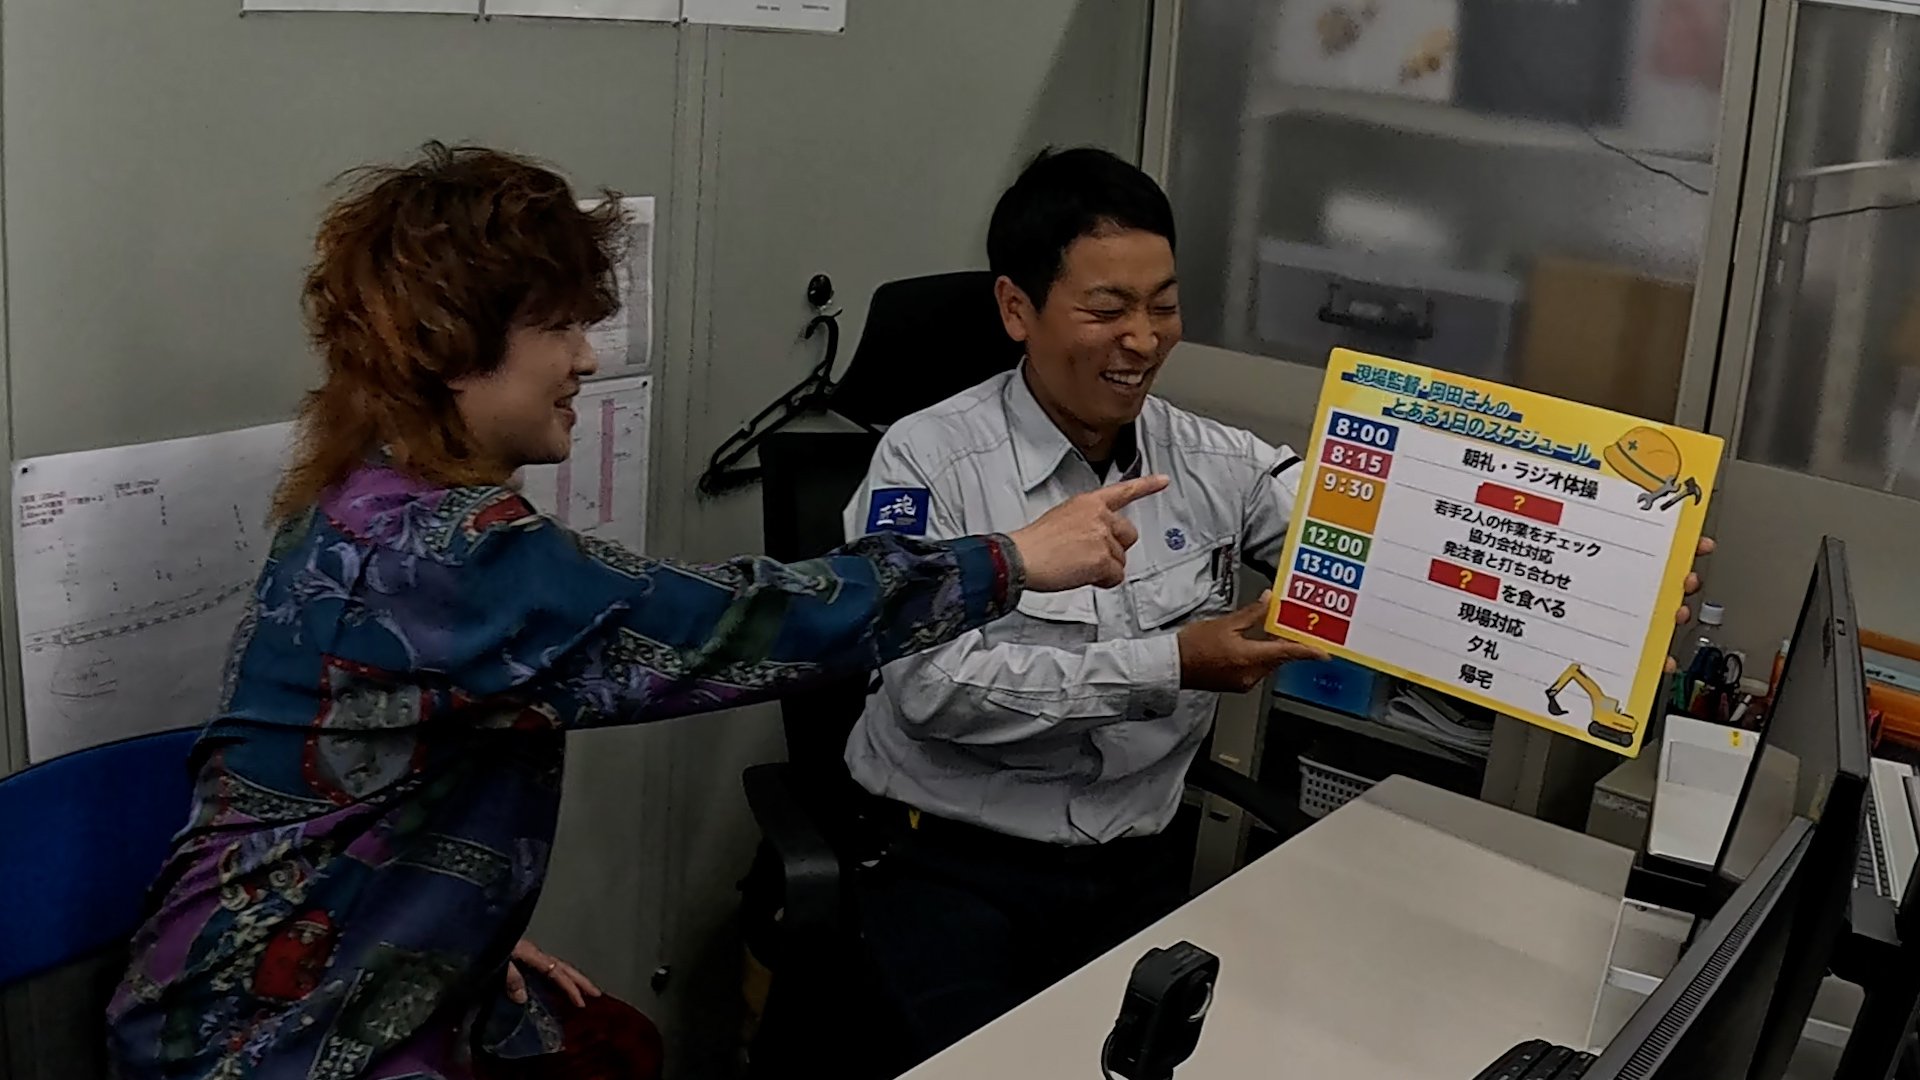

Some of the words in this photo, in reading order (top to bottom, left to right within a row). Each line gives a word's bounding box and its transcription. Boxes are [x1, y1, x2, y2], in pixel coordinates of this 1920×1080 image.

[1336, 418, 1389, 445] 8:00
[1391, 397, 1592, 463] とある1日のスケジュール
[1331, 445, 1382, 473] 8:15
[1462, 448, 1598, 500] 朝礼・ラジオ体操
[1324, 473, 1374, 501] 9:30
[1308, 526, 1363, 556] 12:00
[1434, 499, 1601, 557] 若手2人の作業をチェック
[1469, 527, 1555, 564] 協力会社対応
[1301, 553, 1356, 584] 13:00
[1443, 541, 1572, 590] 発注者と打ち合わせ
[1294, 580, 1350, 612] 17:00
[1502, 584, 1566, 618] を食べる
[1458, 602, 1526, 637] 現場対応
[1467, 635, 1499, 660] 夕礼
[1459, 664, 1493, 689] 帰宅
